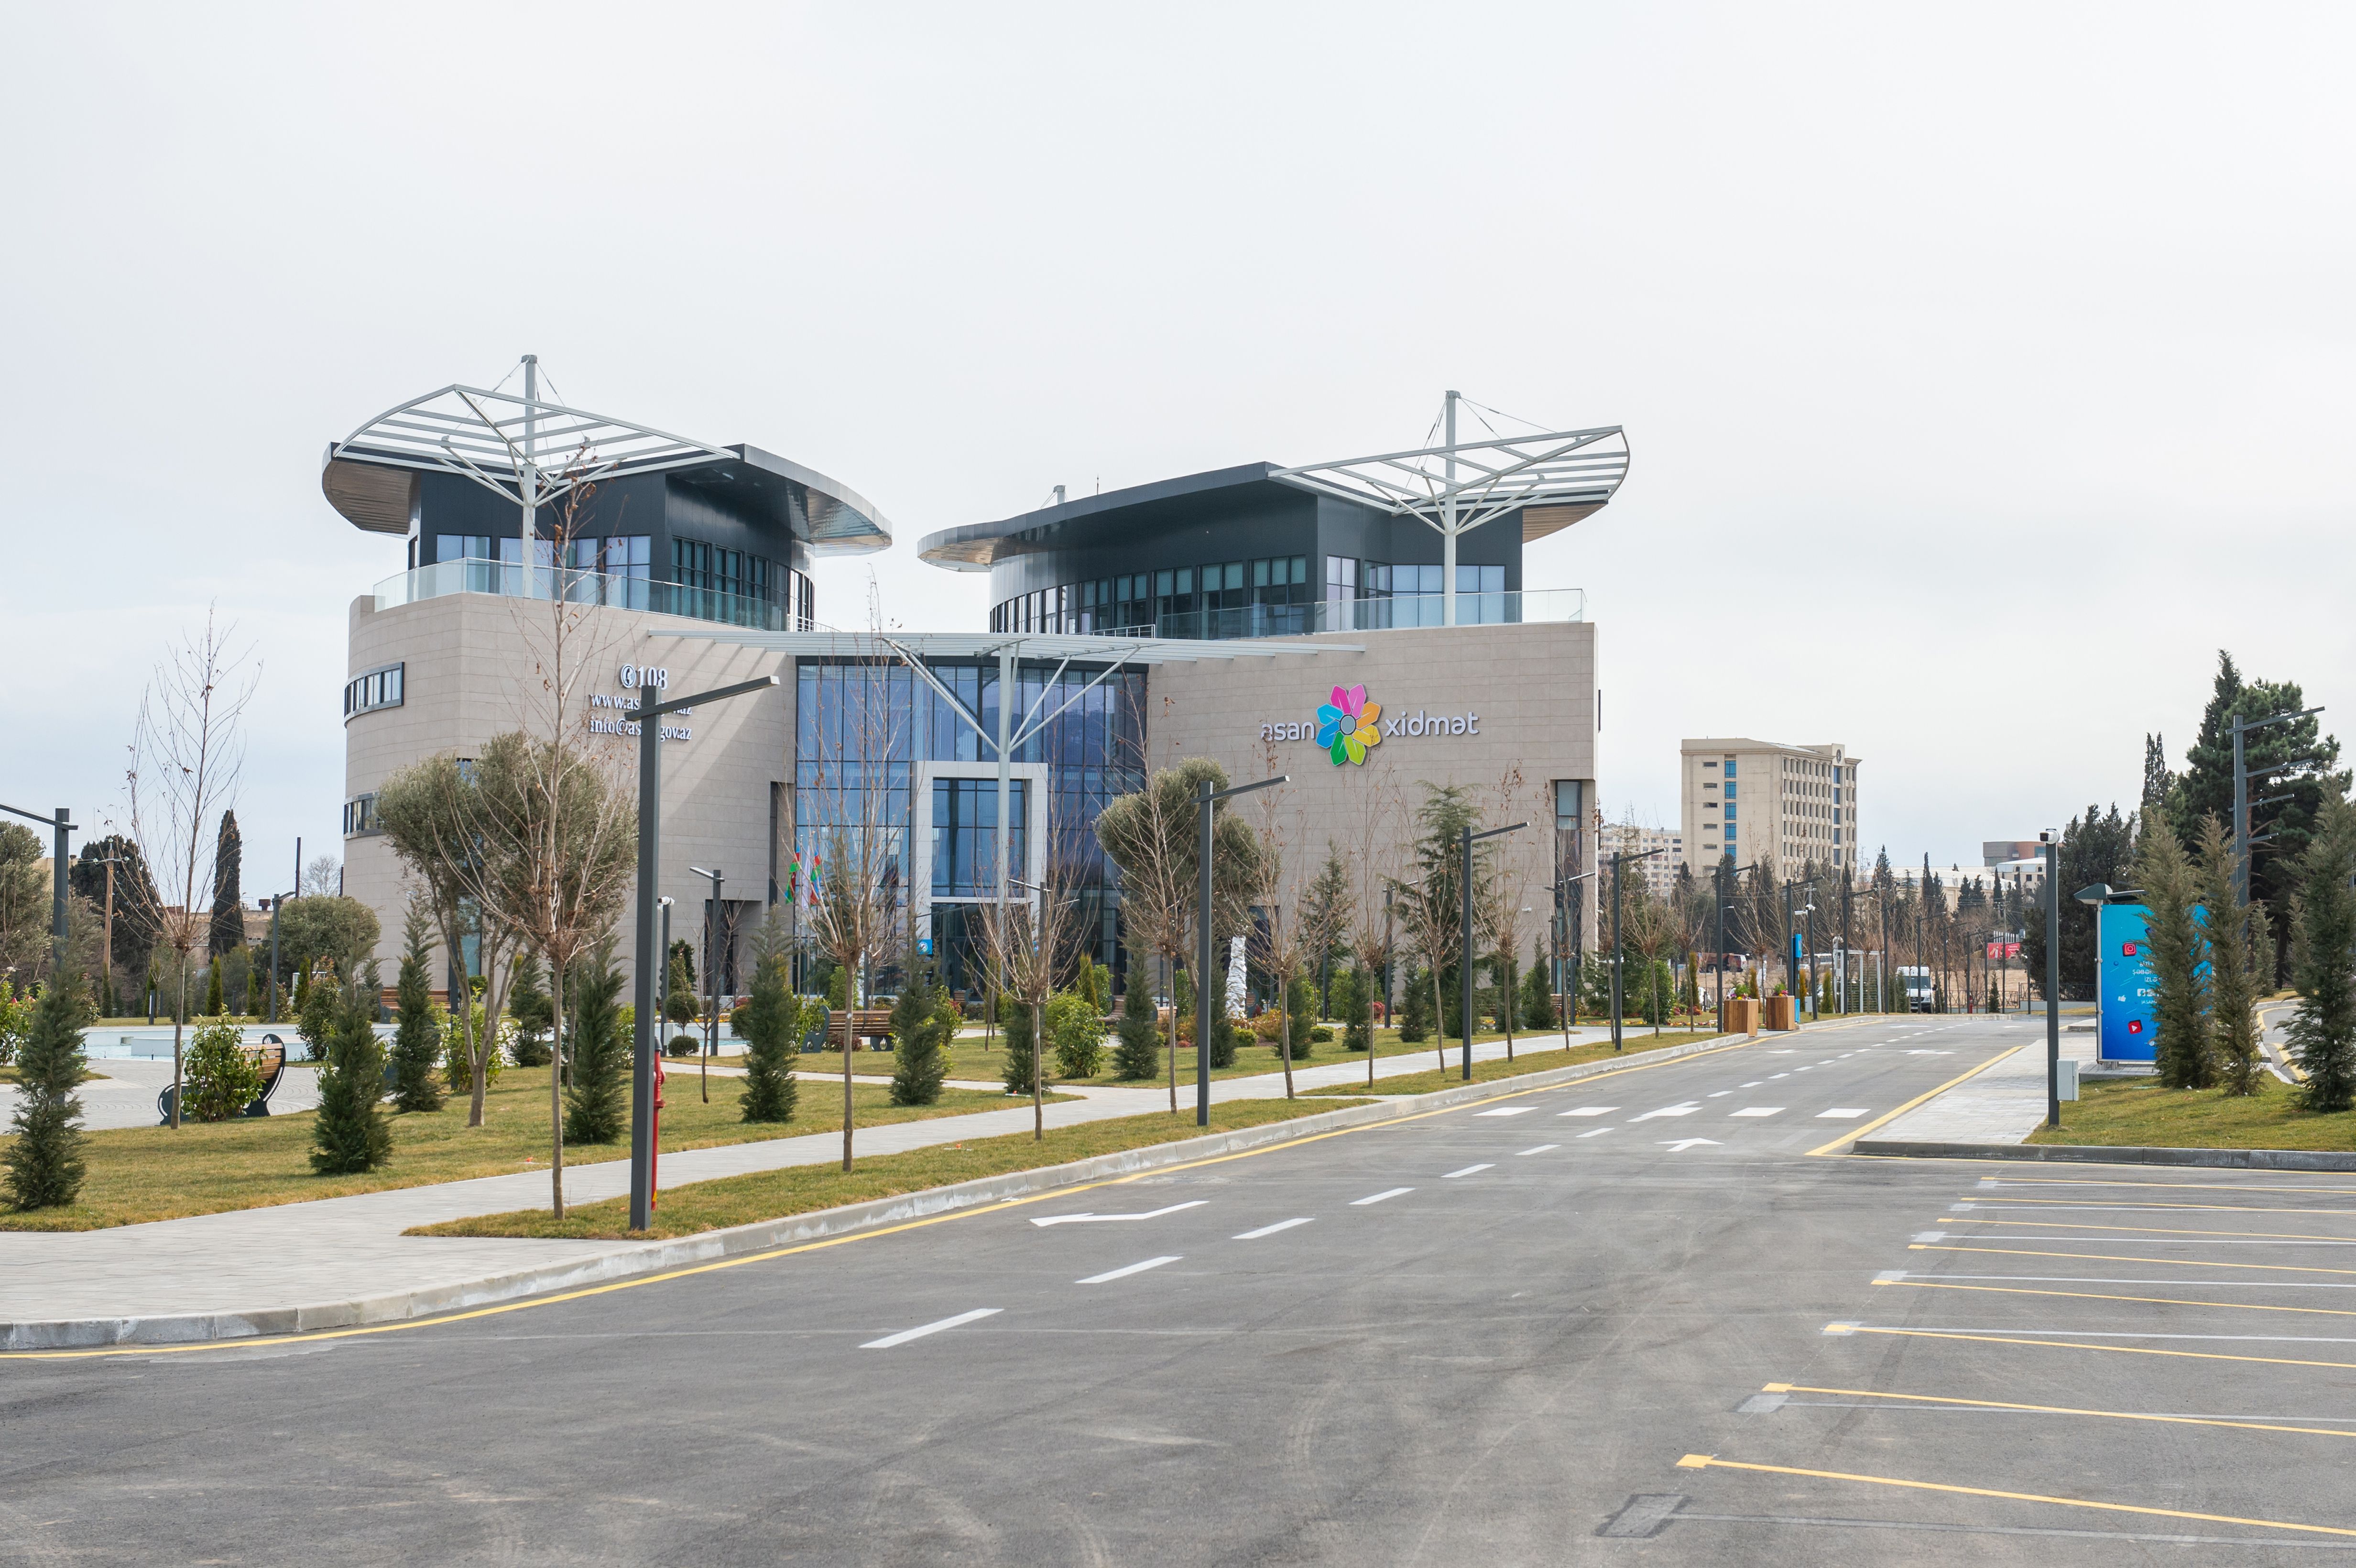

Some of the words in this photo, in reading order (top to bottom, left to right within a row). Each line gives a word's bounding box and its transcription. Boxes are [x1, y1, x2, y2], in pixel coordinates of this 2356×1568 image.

[637, 666, 668, 690] 108
[590, 716, 692, 742] info@asgov.az
[1261, 722, 1315, 741] asan
[1385, 710, 1480, 736] xidmət
